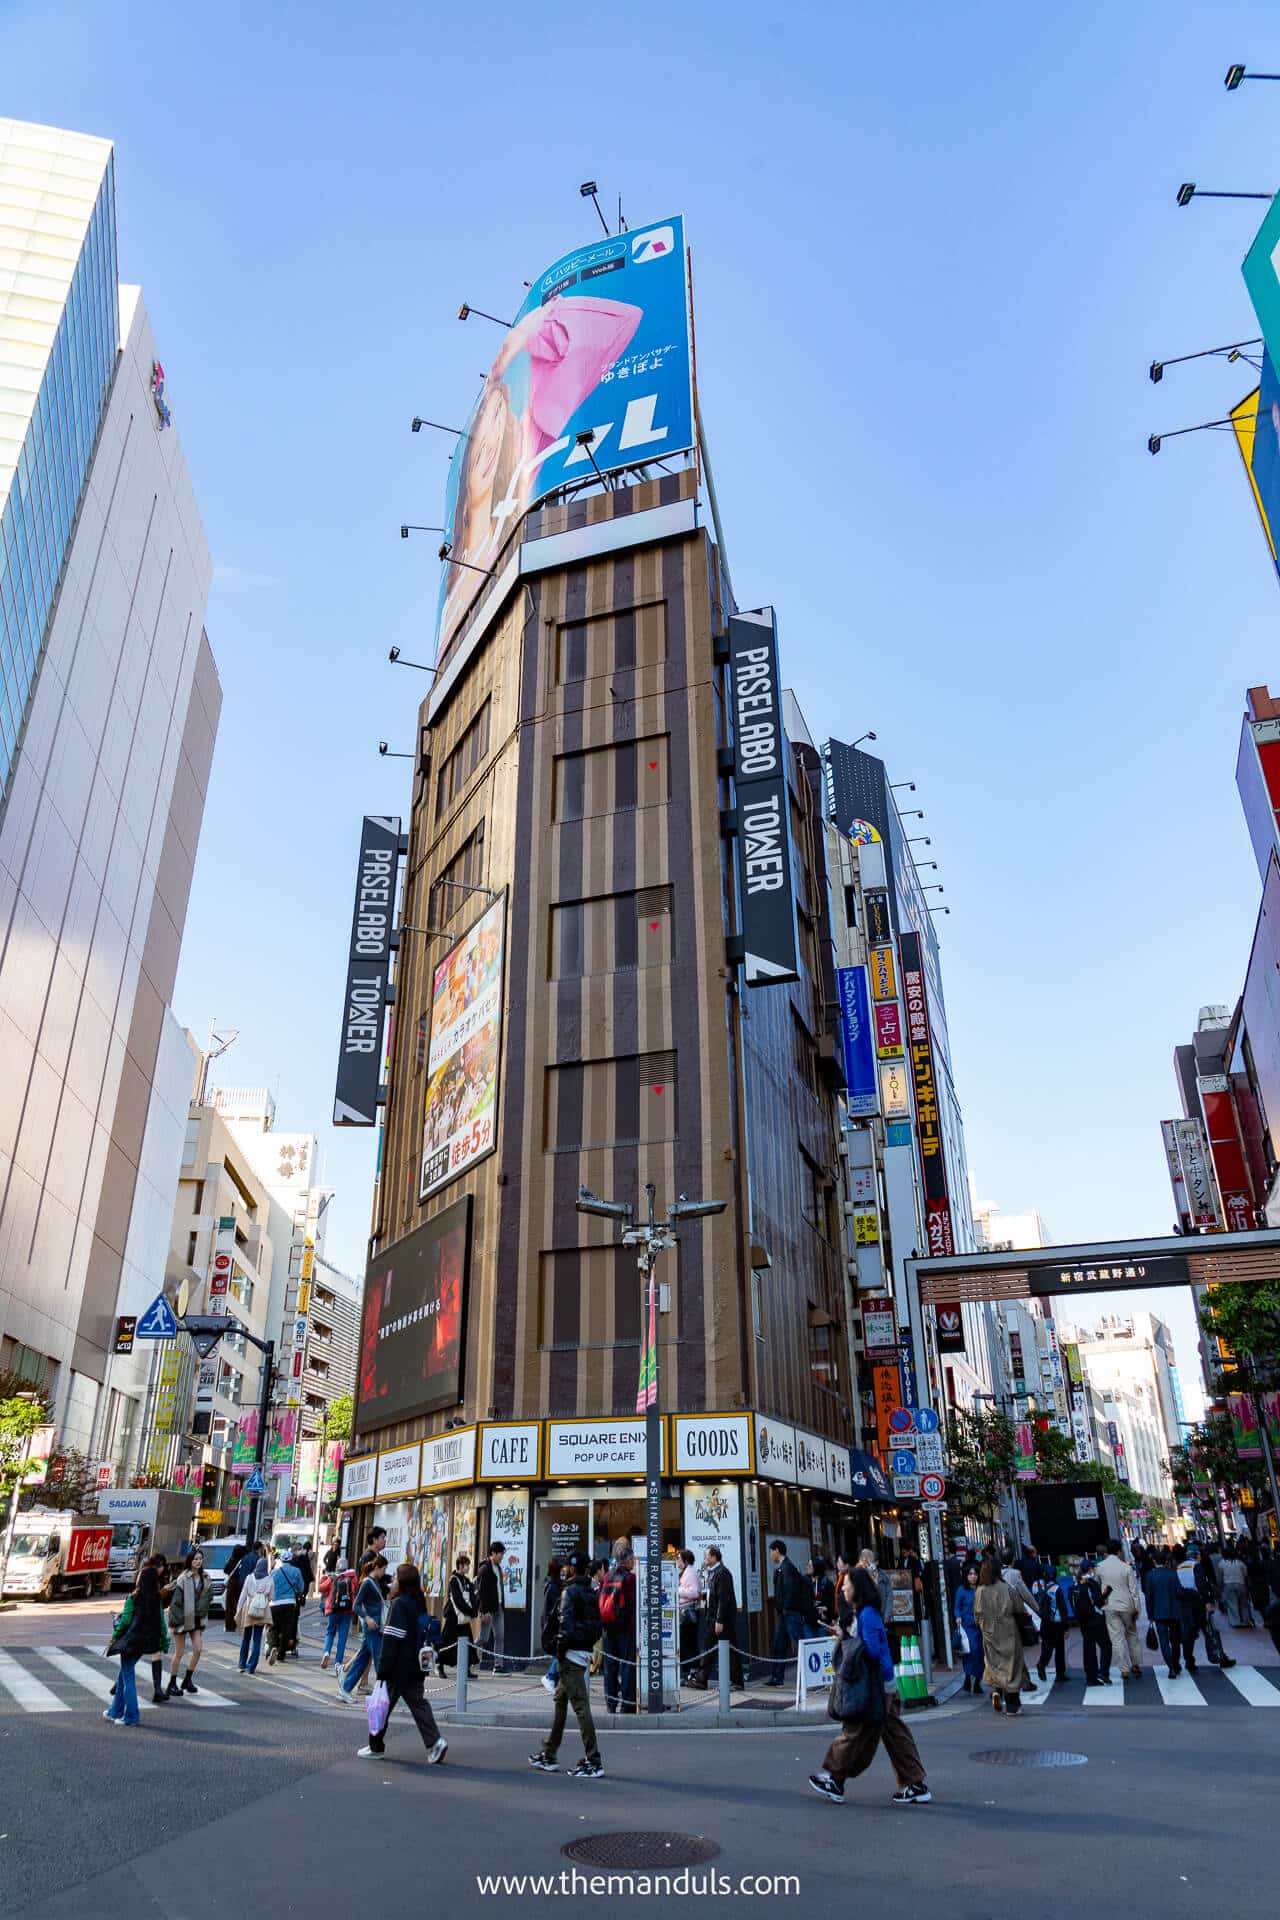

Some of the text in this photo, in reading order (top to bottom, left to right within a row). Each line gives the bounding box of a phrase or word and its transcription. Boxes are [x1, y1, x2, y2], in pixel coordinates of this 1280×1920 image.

[735, 645, 784, 895] PASELABO TOWER
[345, 848, 393, 1054] PASELABO TOWER
[842, 971, 860, 1042] アパマンショップ
[904, 971, 928, 1041] 驚安の殿堂
[880, 1021, 897, 1046] 占い
[491, 1437, 529, 1464] CAFE
[558, 1431, 648, 1447] SQUARE ENIX
[686, 1429, 739, 1457] GOODS
[574, 1452, 636, 1462] POP UP CAFE
[925, 1480, 940, 1495] 30
[108, 1499, 147, 1509] SAGAWA
[649, 1486, 660, 1690] SHINJUKU RAMBLING ROAD
